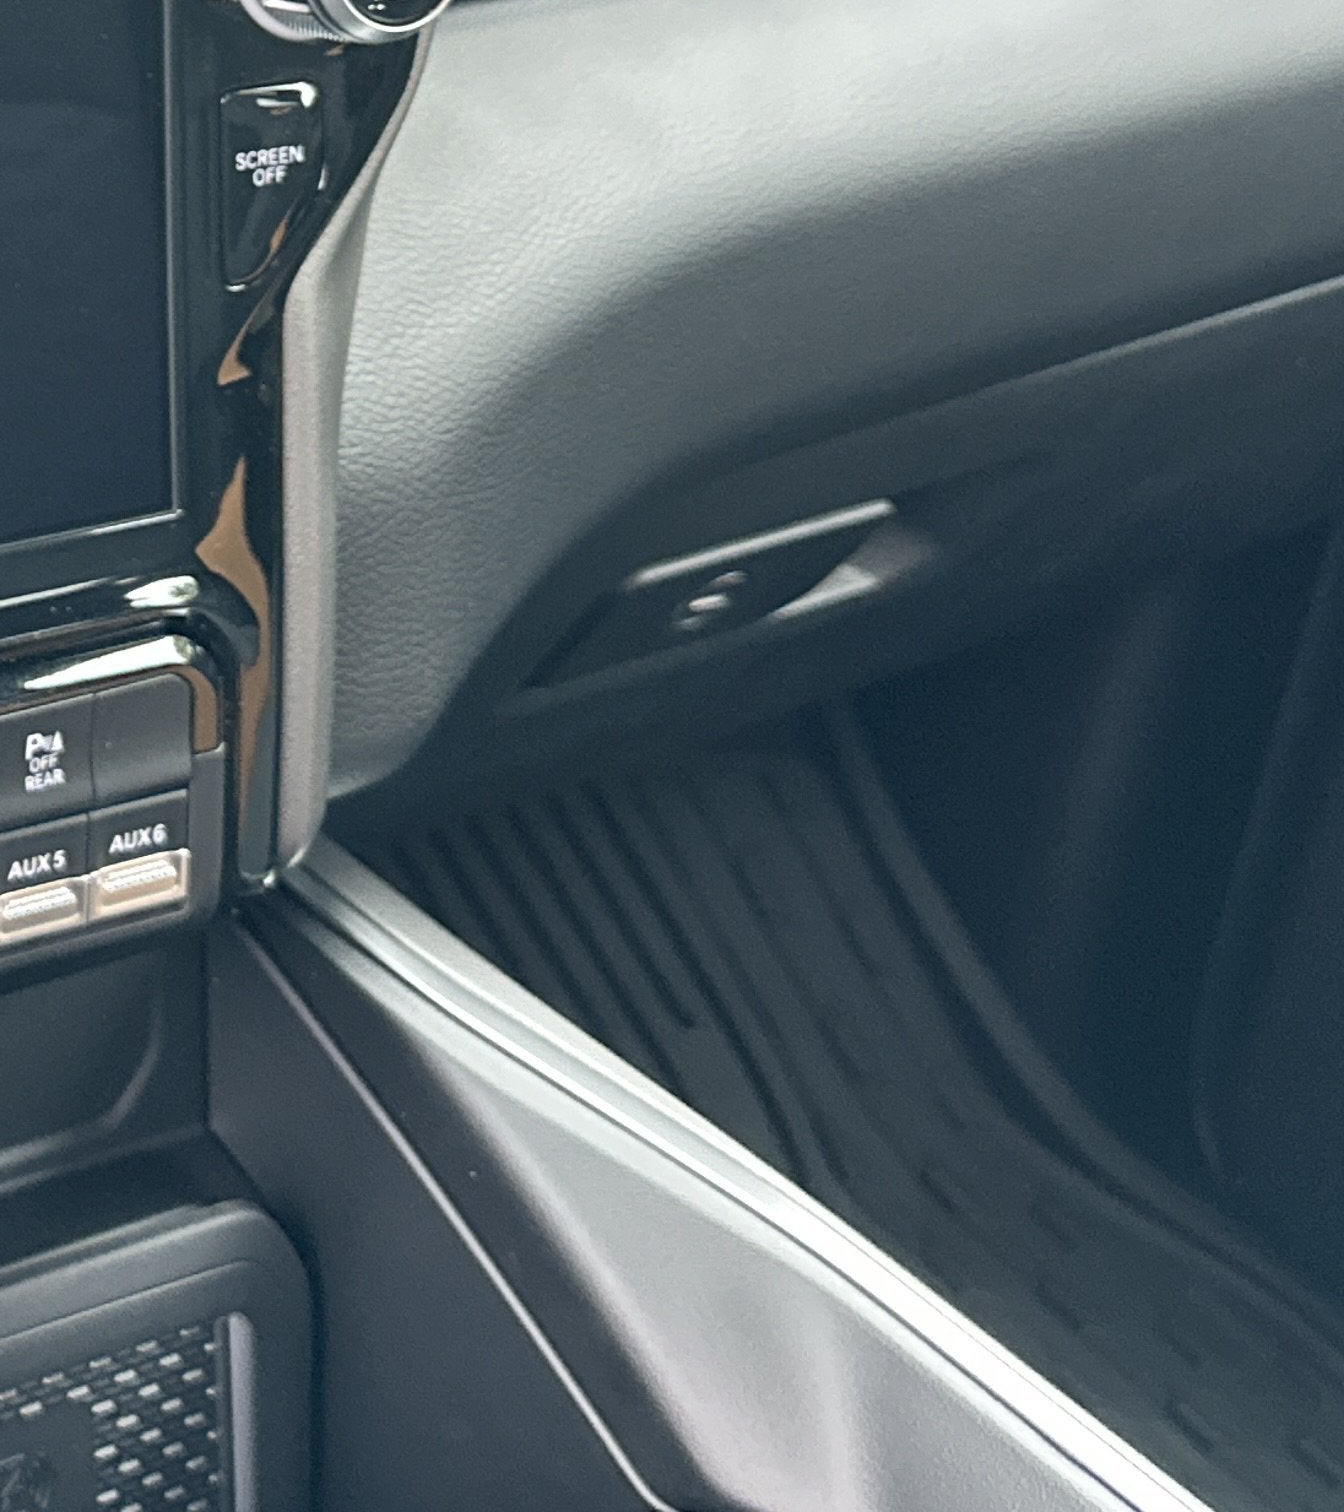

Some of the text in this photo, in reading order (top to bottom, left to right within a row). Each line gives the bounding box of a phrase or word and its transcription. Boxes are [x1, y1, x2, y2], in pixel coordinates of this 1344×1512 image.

[235, 145, 304, 172] SCREEN
[253, 165, 286, 187] OFF
[29, 753, 58, 773] OFF
[25, 769, 65, 791] REAR
[109, 823, 166, 853] AUX 6
[8, 850, 66, 880] AUX 5
